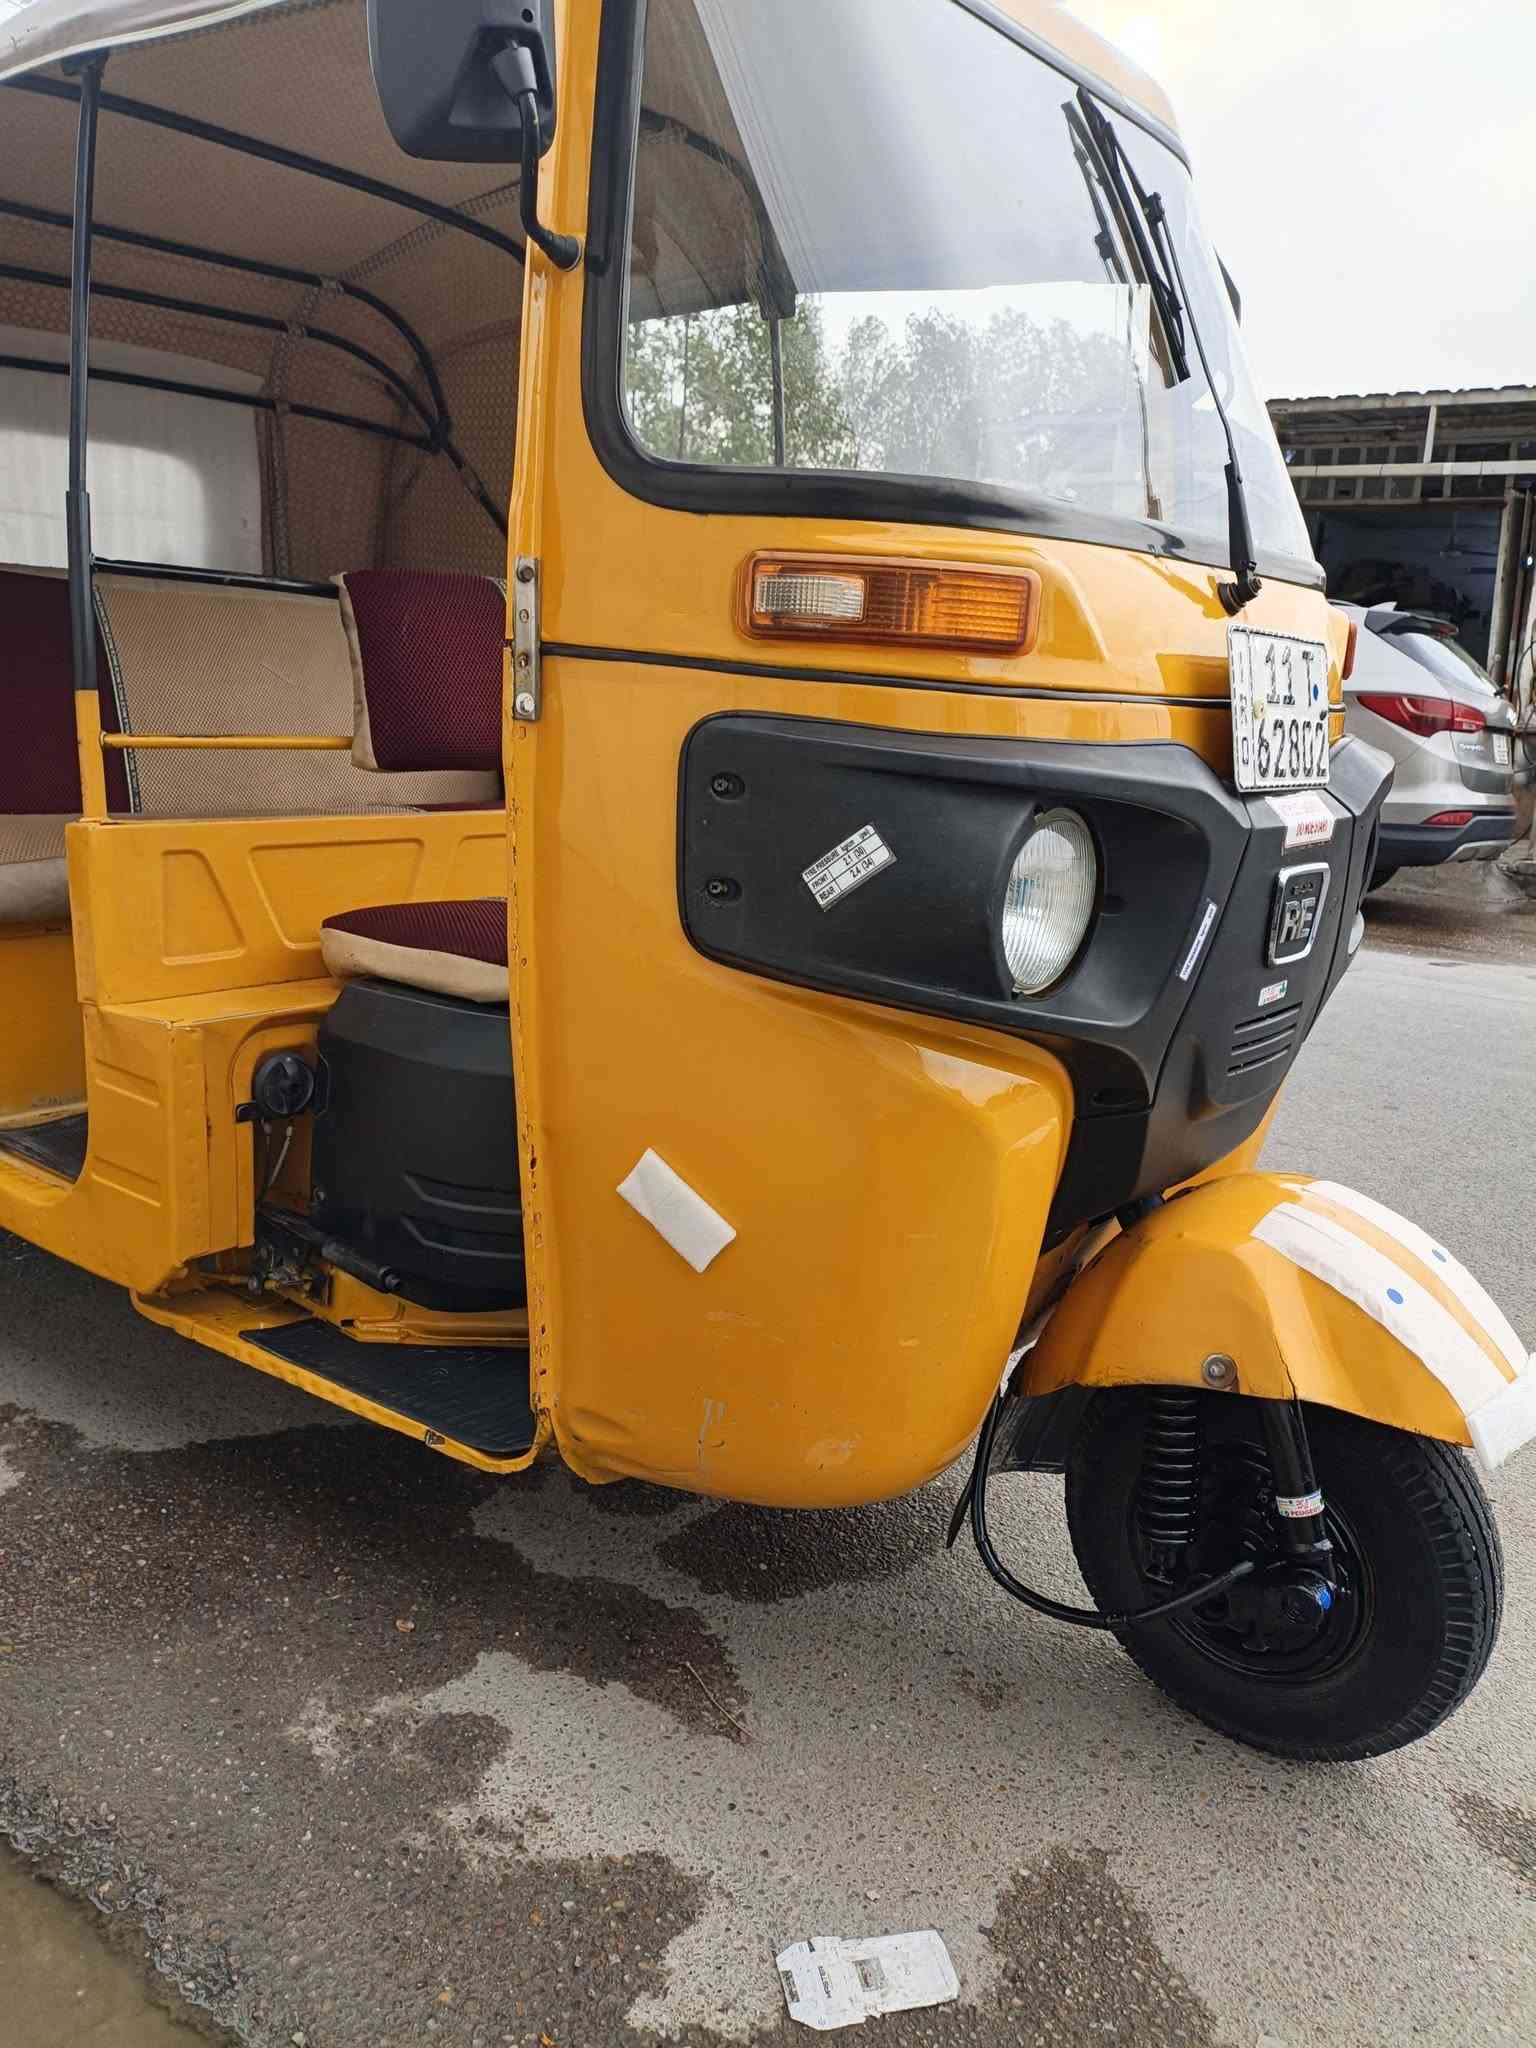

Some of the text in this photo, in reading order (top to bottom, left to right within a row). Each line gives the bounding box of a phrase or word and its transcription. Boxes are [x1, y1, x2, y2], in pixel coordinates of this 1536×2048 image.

[1257, 718, 1328, 778] 62802
[818, 885, 836, 902] REAR
[1279, 897, 1316, 944] RE
